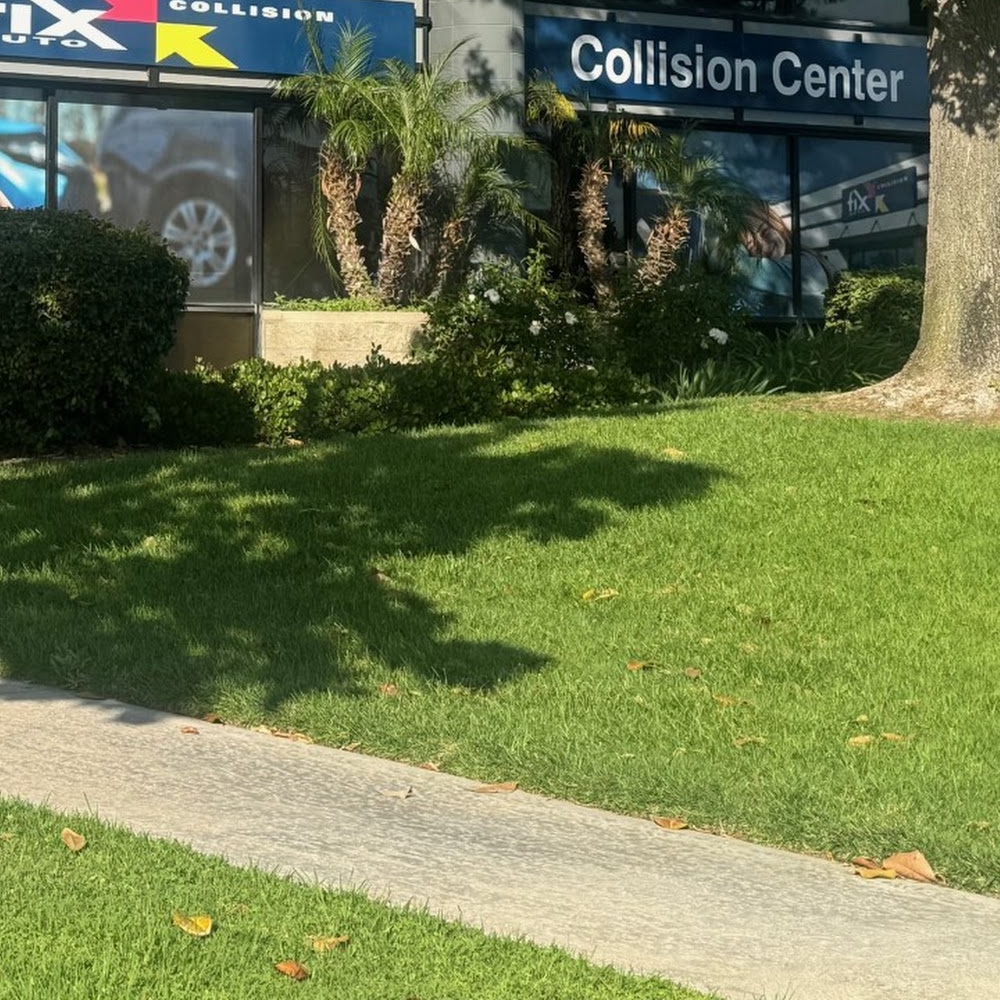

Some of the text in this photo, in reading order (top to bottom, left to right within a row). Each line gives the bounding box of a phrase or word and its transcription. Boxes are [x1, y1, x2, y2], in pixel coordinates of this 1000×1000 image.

[168, 0, 334, 23] COLLISION
[571, 34, 904, 102] Collision Center
